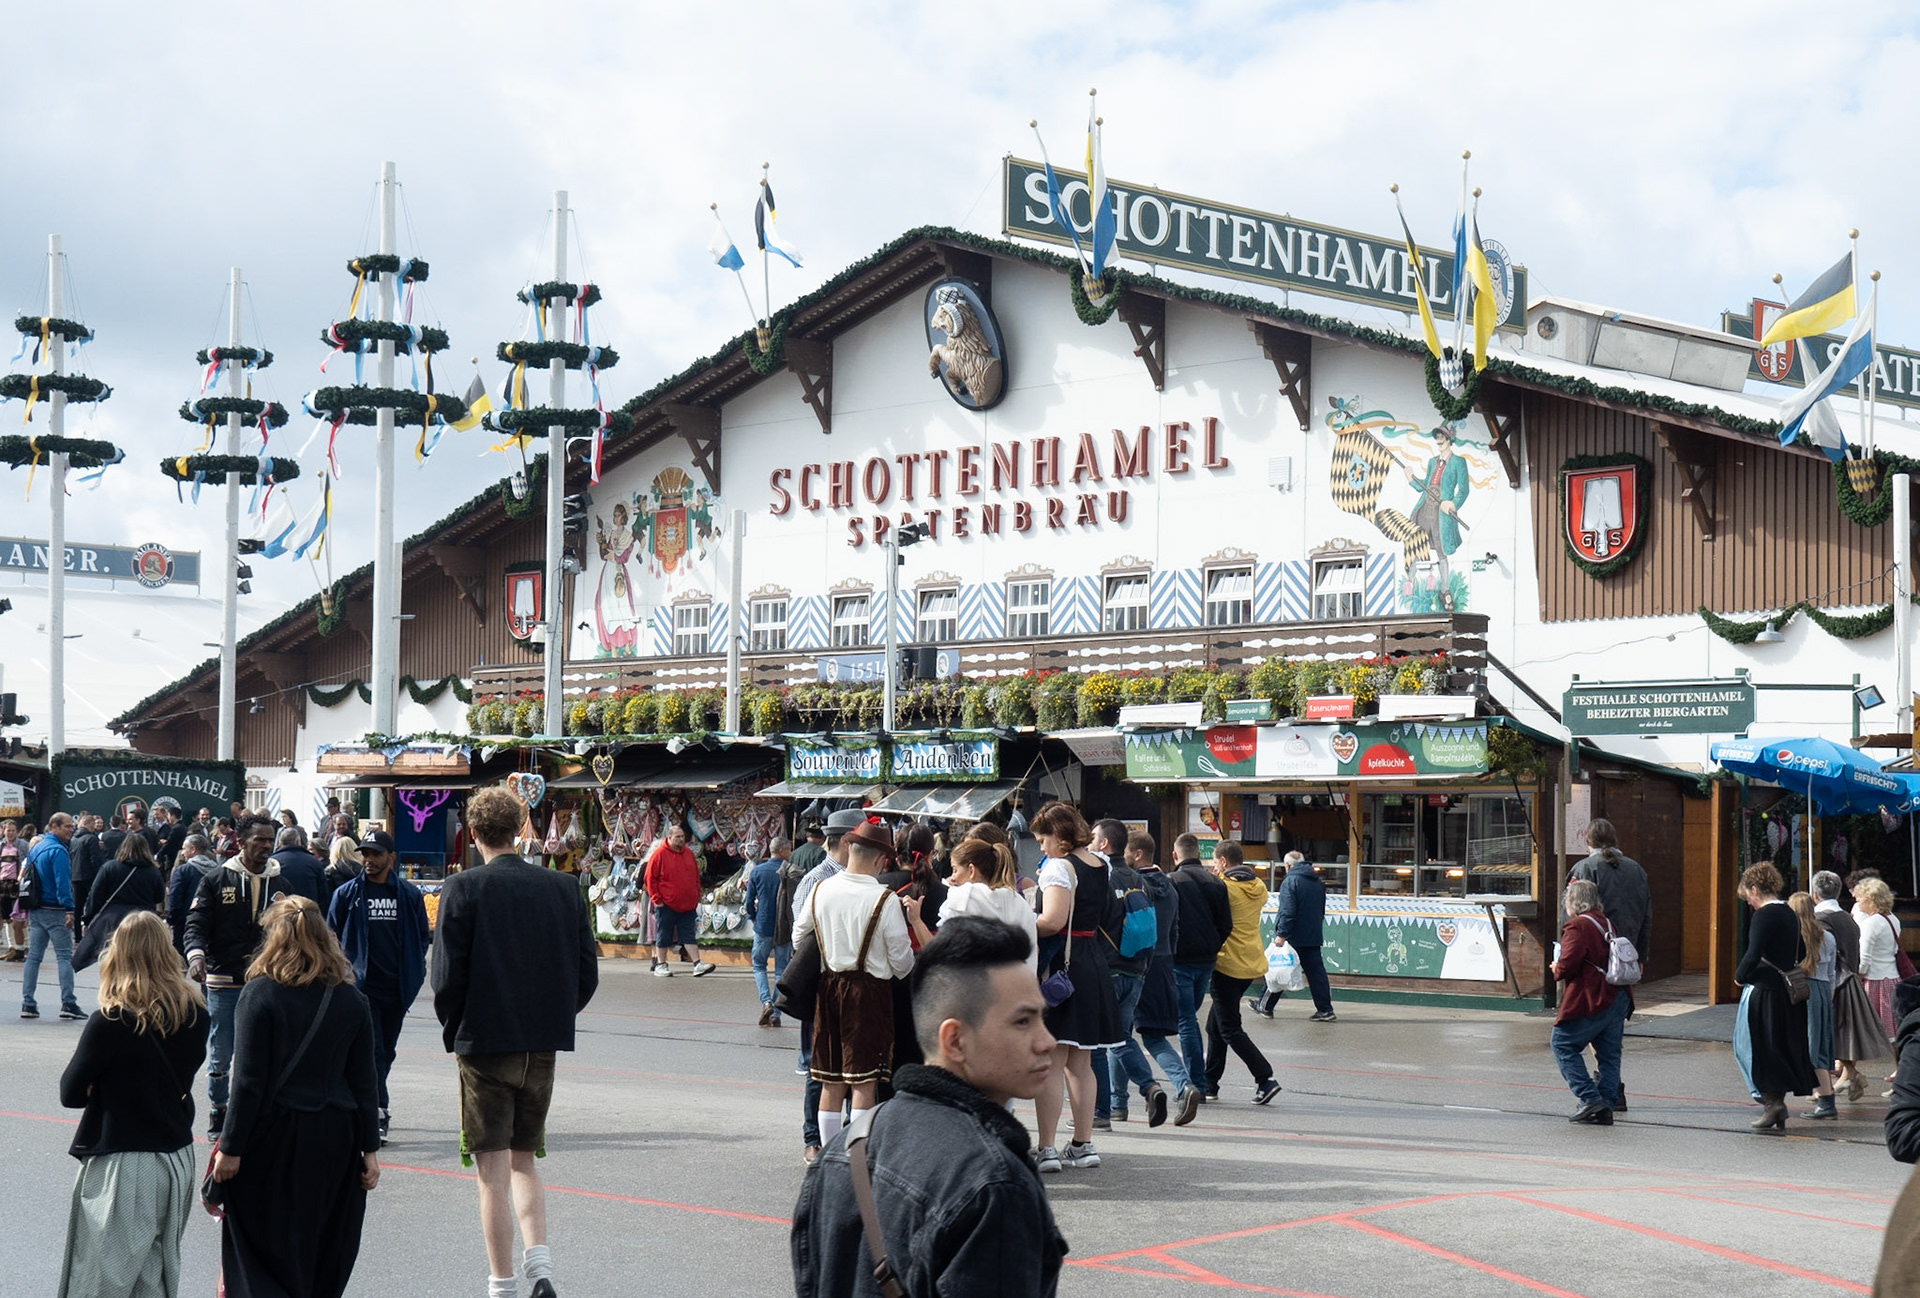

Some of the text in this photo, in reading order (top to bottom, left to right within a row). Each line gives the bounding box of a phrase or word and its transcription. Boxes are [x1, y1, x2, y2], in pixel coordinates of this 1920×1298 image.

[1025, 172, 1450, 304] SCHOTTENHAMEL
[1779, 357, 1787, 371] S
[769, 416, 1229, 515] SCHOTTENHAMEL
[1581, 531, 1622, 547] G S
[0, 543, 111, 574] ANER.
[1572, 690, 1745, 706] FESTHALLE SCHOTTENHAMEL
[1586, 705, 1729, 719] BEHEIZTER BIERGARTEN
[1214, 734, 1235, 743] Strudel
[1467, 743, 1480, 751] und
[793, 744, 993, 771] Souvenier Andenken
[1794, 755, 1829, 769] pepsi
[64, 770, 229, 801] SCHOTTENHAMEL
[1853, 771, 1898, 791] ERFRISCHT?
[222, 893, 236, 904] 23
[368, 909, 398, 917] EANS
